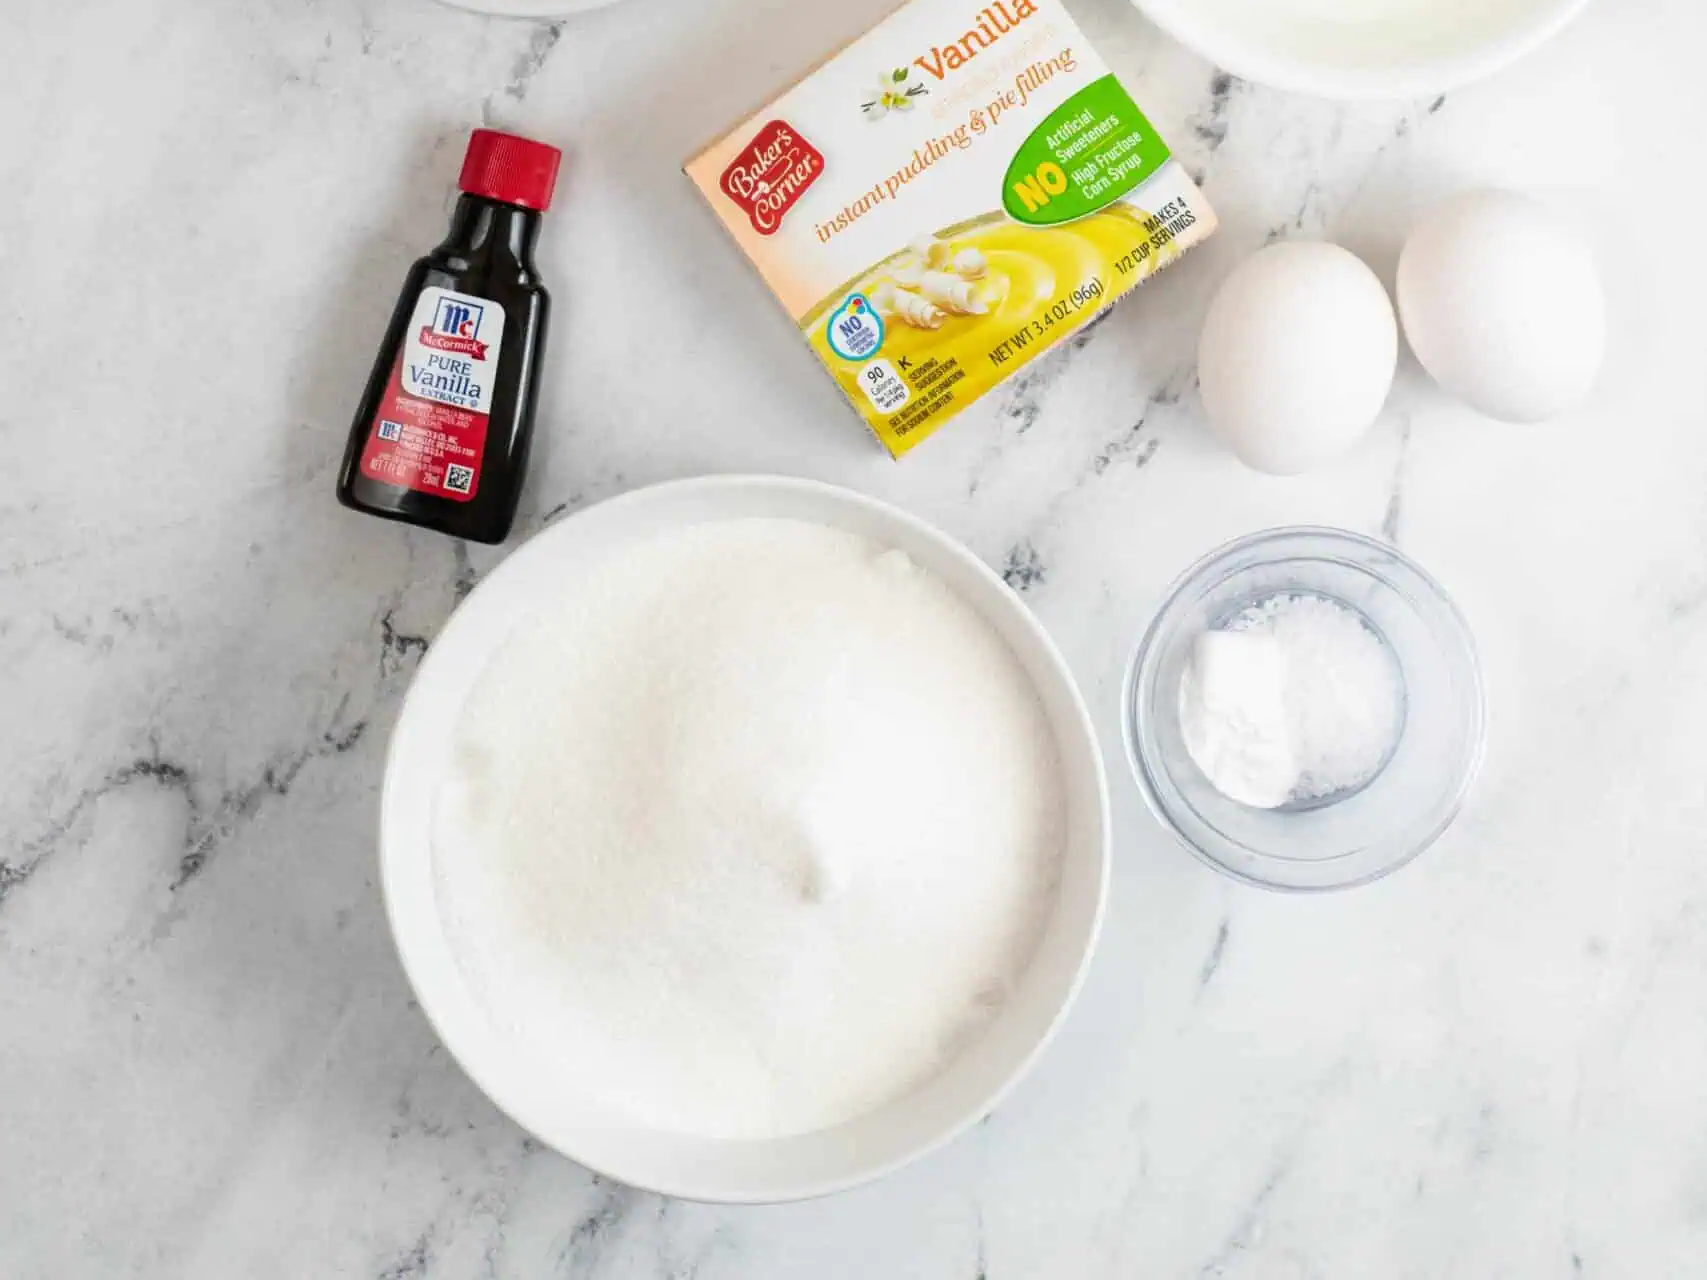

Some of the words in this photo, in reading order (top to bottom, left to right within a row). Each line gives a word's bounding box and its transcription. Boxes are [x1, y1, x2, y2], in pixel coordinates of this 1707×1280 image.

[814, 183, 886, 244] instant
[884, 124, 972, 199] pudding
[969, 108, 988, 136] &
[986, 91, 1017, 125] pie
[1014, 47, 1078, 107] filling
[1046, 107, 1096, 150] Artificial
[1056, 114, 1120, 164] Sweeteners
[728, 128, 793, 198] Baker's
[1071, 161, 1099, 187] High
[1095, 131, 1143, 168] Fructose
[1082, 176, 1112, 200] Corn
[1107, 153, 1143, 182] Syrup
[755, 152, 813, 229] Corner
[1012, 160, 1068, 213] NO
[1143, 202, 1178, 233] MAKES
[1177, 196, 1188, 208] 4
[1114, 256, 1135, 276] 1/2
[1131, 242, 1151, 264] CUP
[1149, 210, 1197, 250] SERVINGS
[422, 334, 480, 354] McCormick
[840, 315, 862, 338] NO
[988, 341, 1015, 368] NET
[1010, 326, 1035, 350] WT
[1032, 313, 1056, 336] 3.4
[1052, 300, 1073, 321] OZ
[1068, 276, 1105, 310] (96g)
[409, 364, 481, 399] Vanilla
[428, 353, 472, 376] PURE
[867, 366, 885, 384] 90
[898, 355, 912, 371] K
[420, 387, 465, 406] EXTRACT
